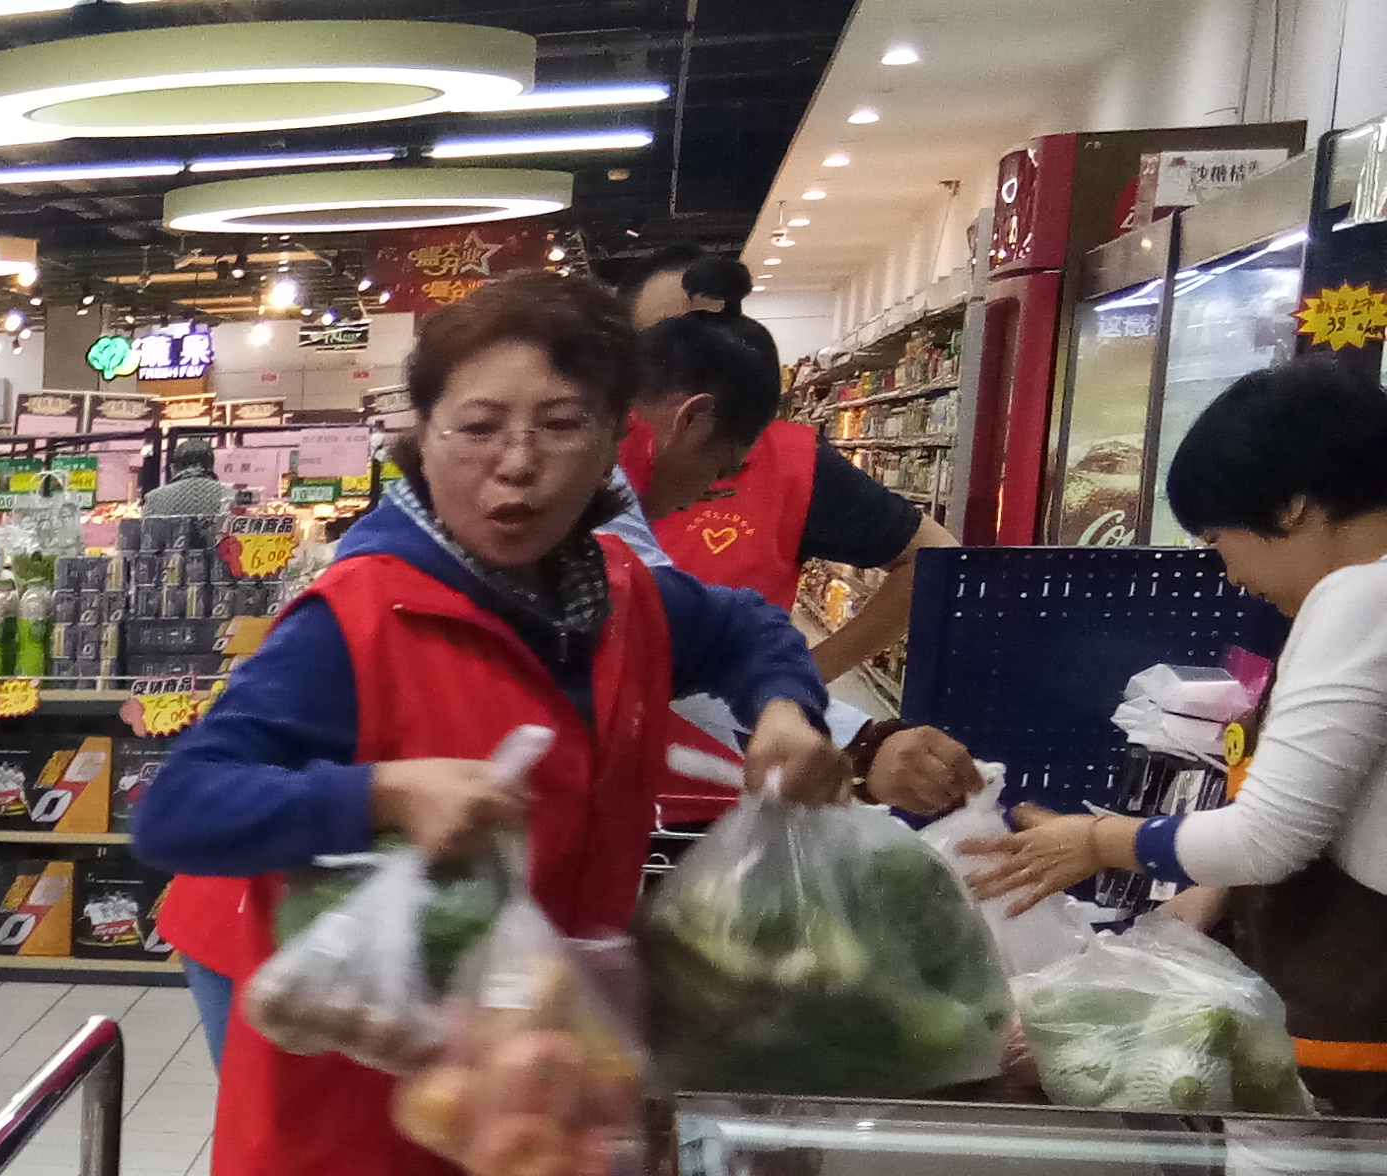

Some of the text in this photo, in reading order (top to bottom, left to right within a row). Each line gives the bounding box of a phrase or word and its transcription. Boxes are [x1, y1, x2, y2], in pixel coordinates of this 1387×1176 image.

[231, 516, 294, 535] 促销商品
[131, 677, 193, 697] 促销商品
